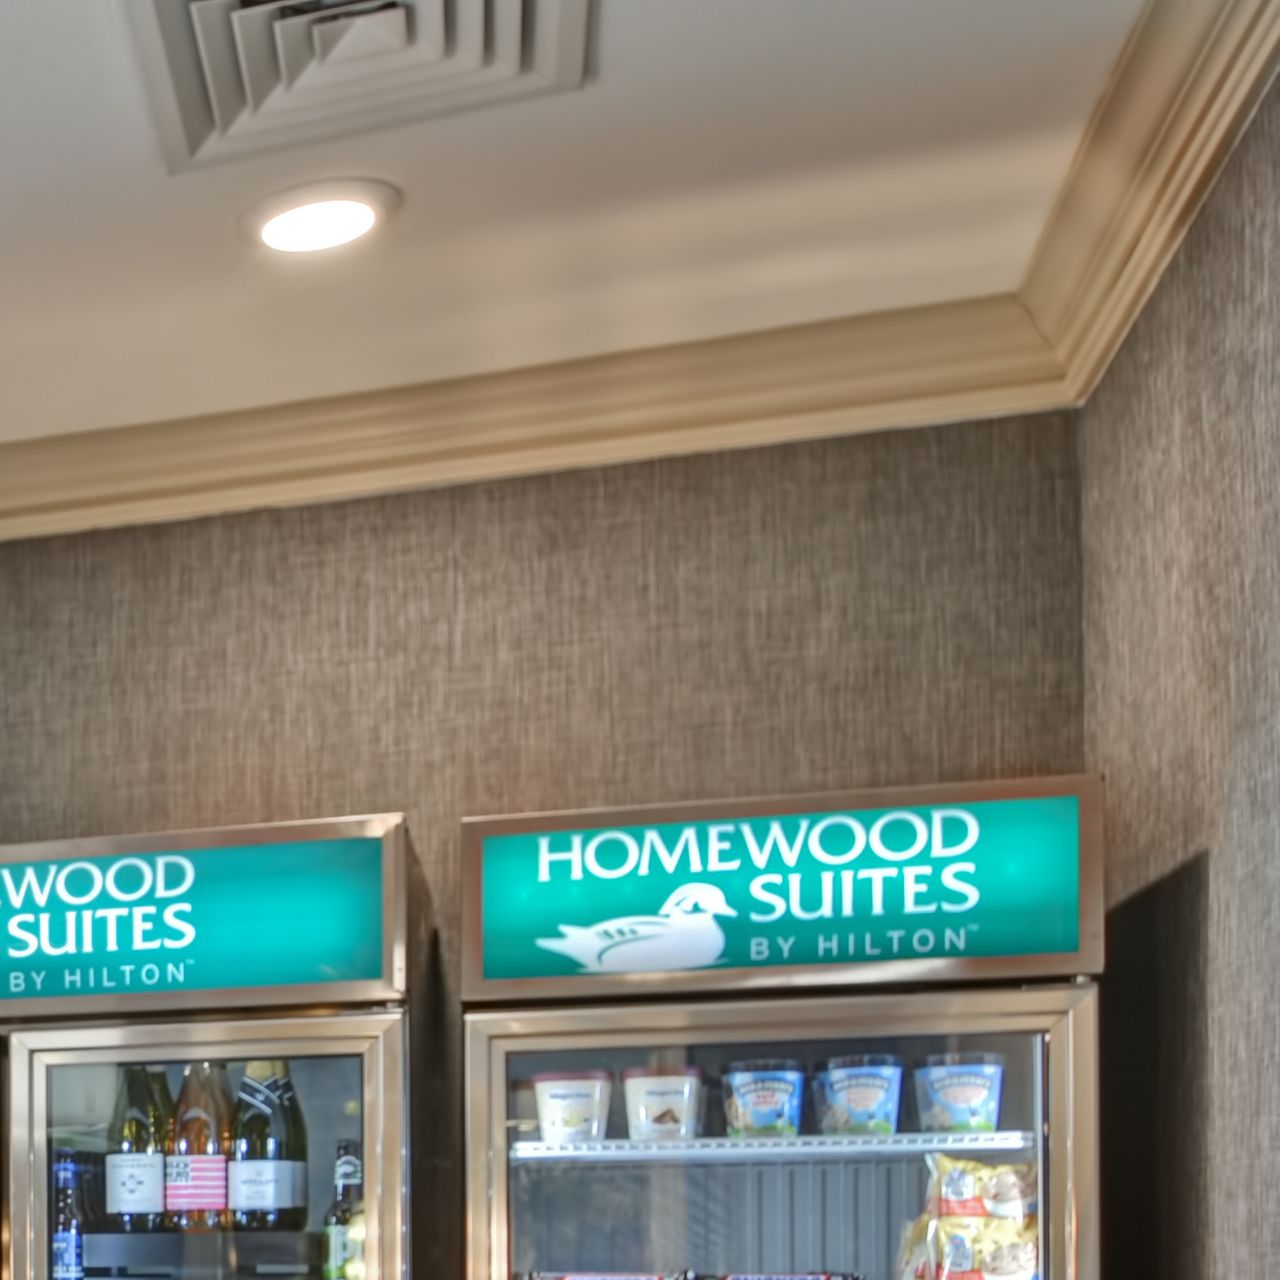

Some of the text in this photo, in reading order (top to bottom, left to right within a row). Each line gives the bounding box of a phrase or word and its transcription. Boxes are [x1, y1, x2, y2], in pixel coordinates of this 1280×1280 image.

[537, 808, 981, 881] HOMEWOOD
[749, 862, 981, 922] SUITES
[7, 902, 196, 958] SUITES
[750, 926, 969, 961] BY HILTON
[8, 962, 187, 993] BY HILTON
